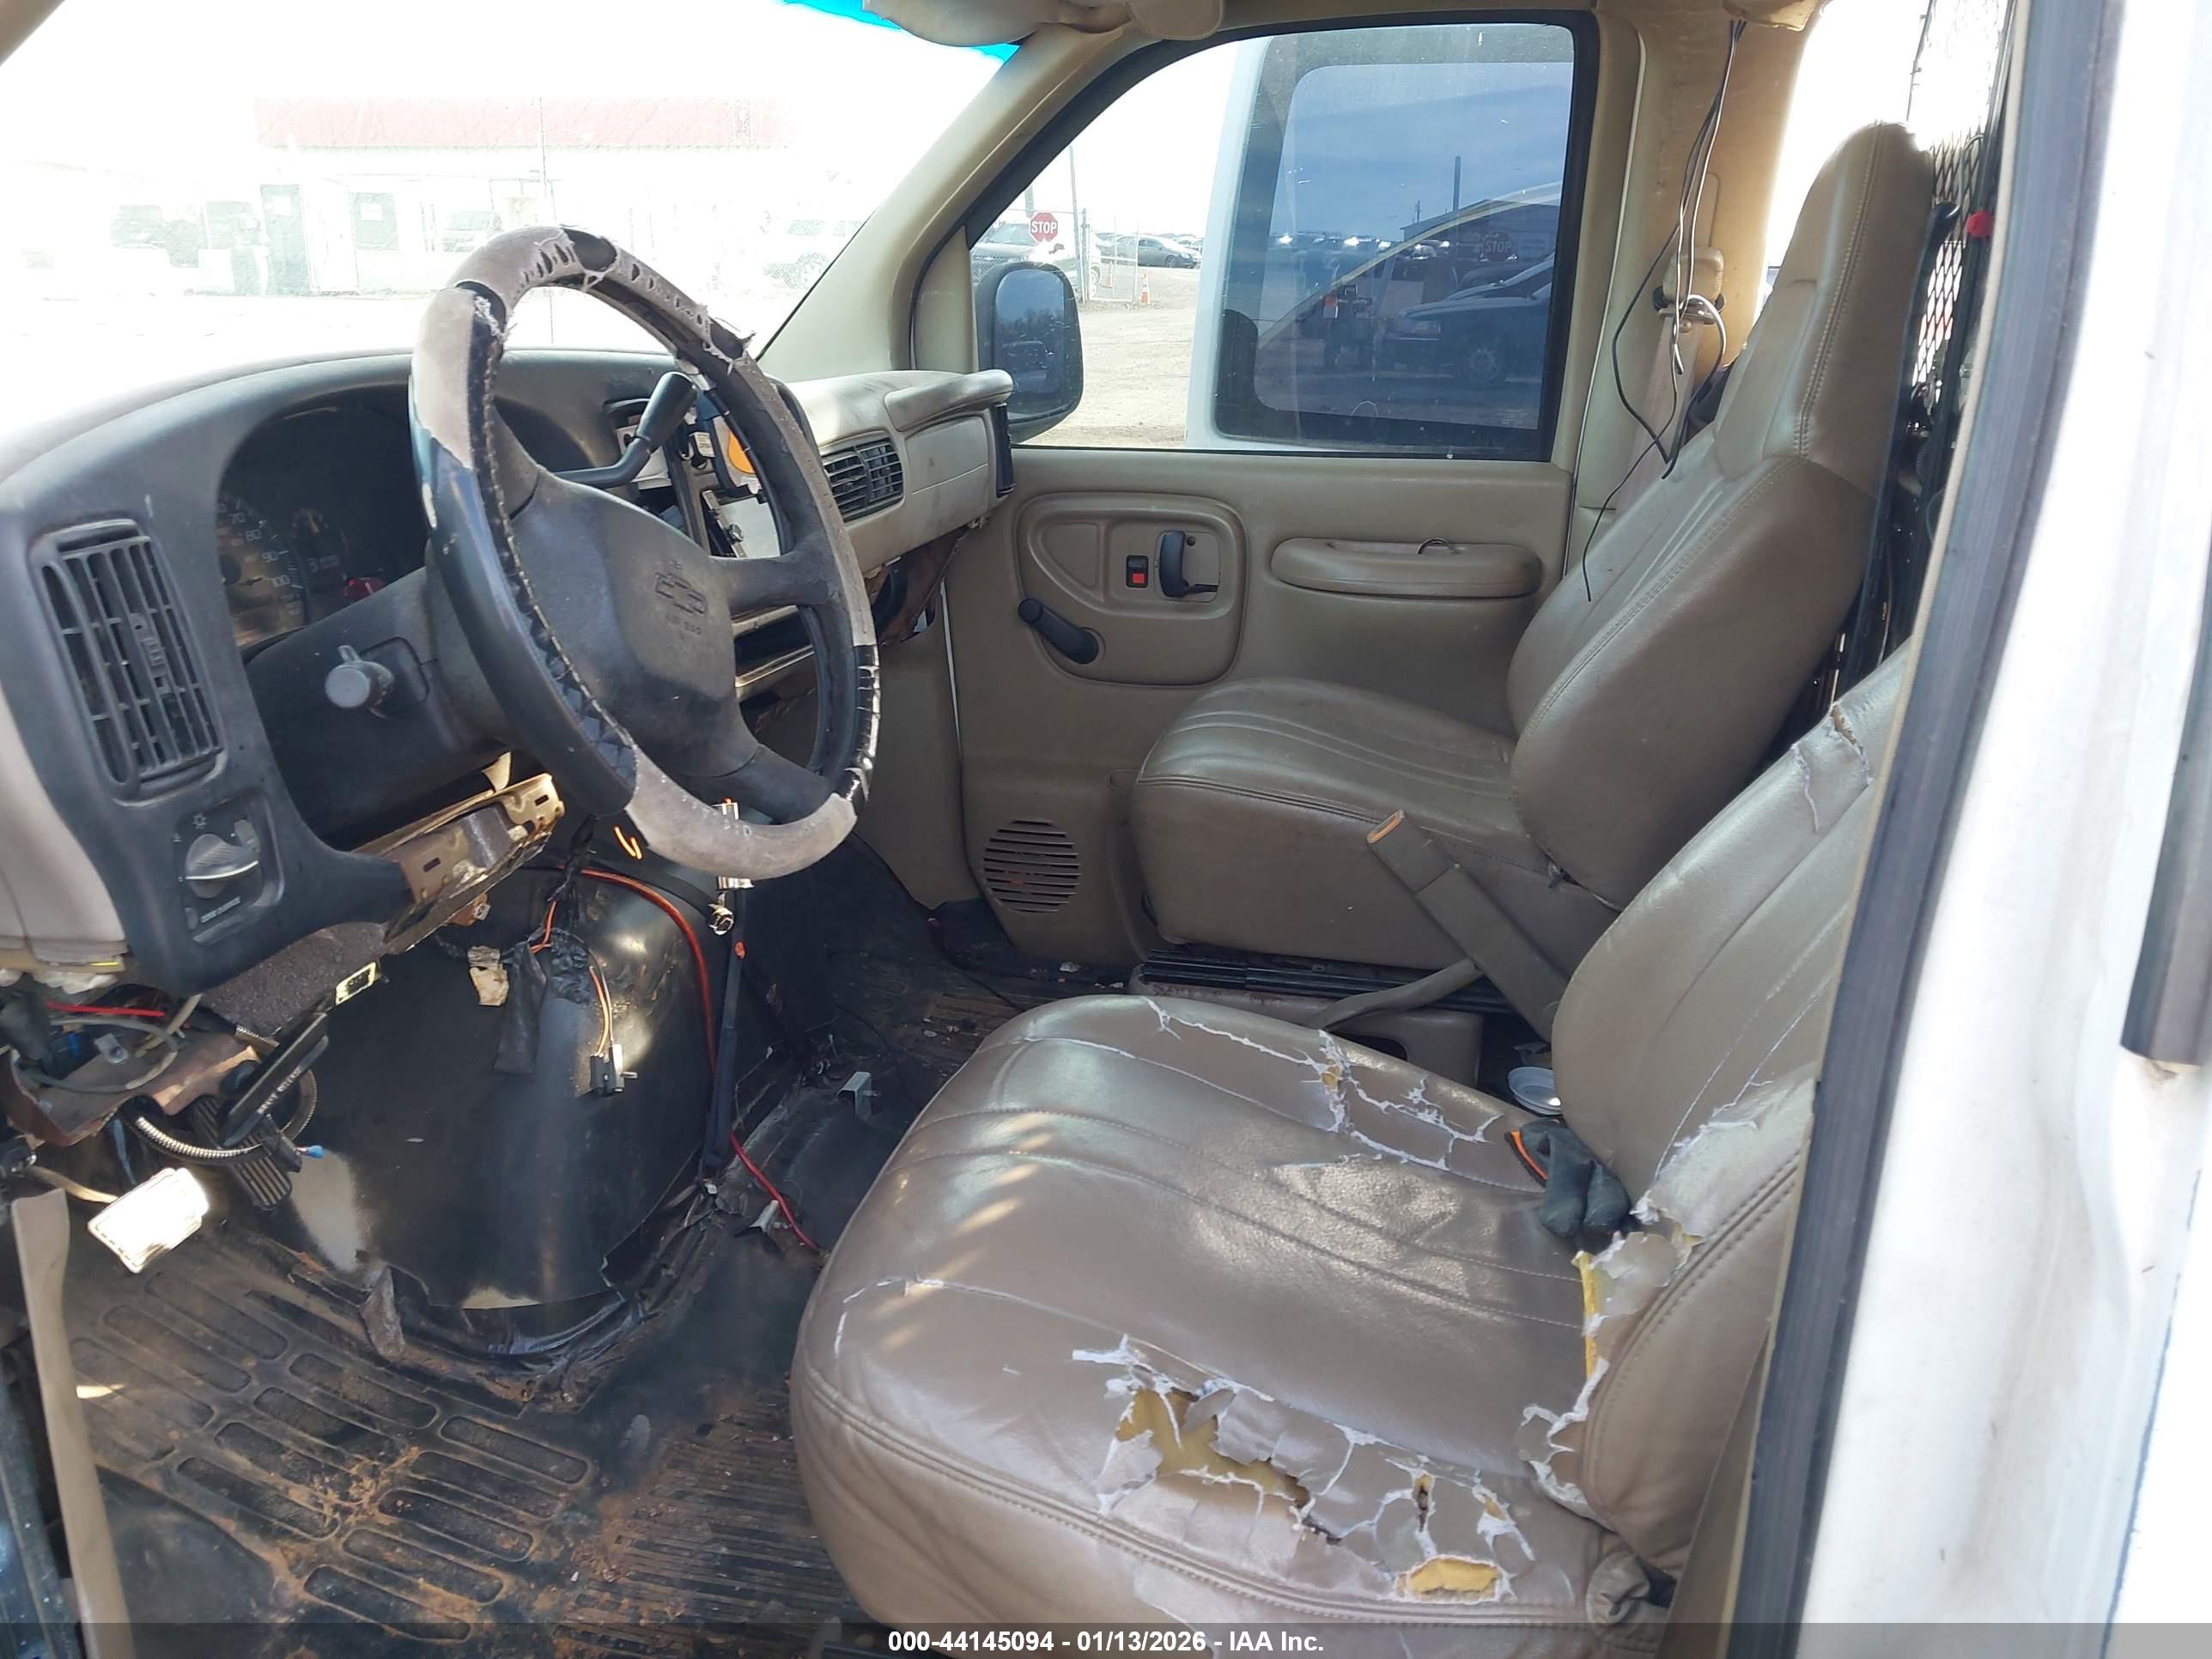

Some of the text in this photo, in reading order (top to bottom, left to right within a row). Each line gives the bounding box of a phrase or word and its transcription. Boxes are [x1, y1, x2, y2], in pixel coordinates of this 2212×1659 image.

[1031, 220, 1057, 234] STOP
[1485, 240, 1512, 254] STOP
[246, 528, 262, 541] 80
[261, 550, 279, 563] 90
